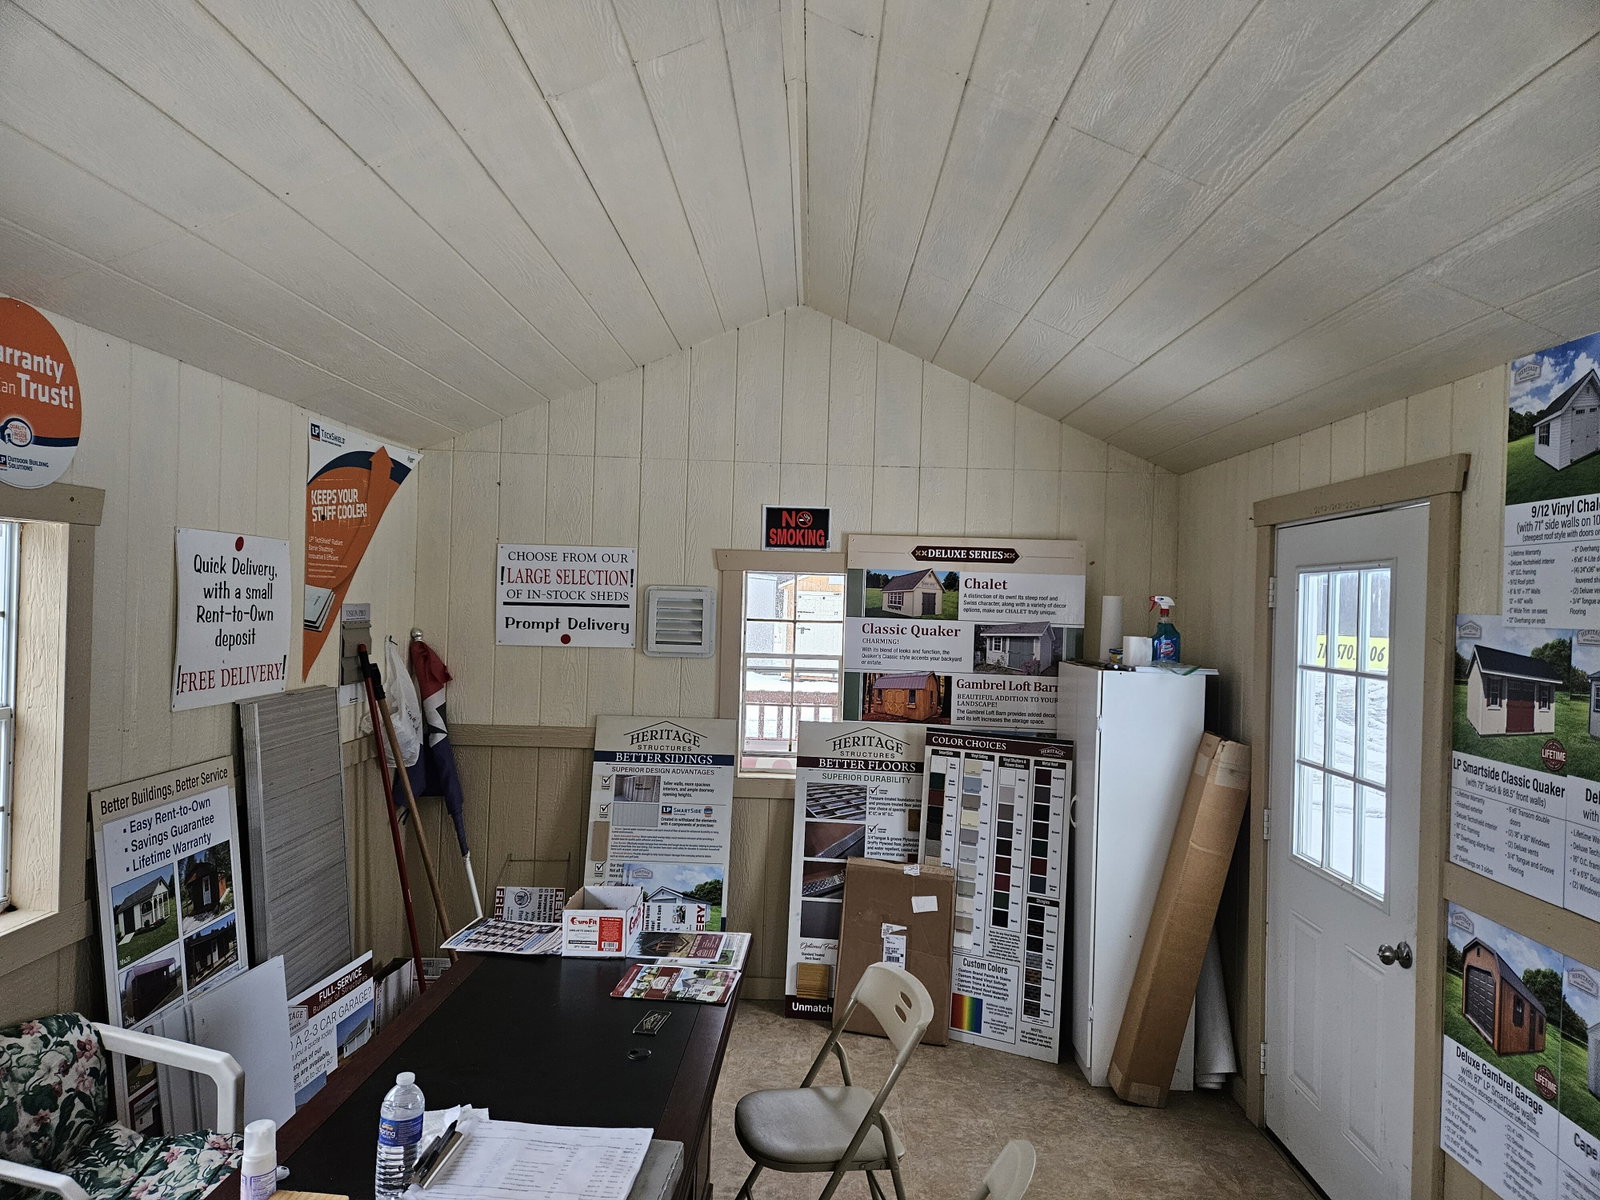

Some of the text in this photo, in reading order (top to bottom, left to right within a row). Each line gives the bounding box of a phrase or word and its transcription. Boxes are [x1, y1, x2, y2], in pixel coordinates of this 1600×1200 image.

[0, 345, 64, 384] rranty
[0, 372, 74, 409] an Trust!
[311, 488, 359, 505] KEEPS YOUR
[337, 503, 368, 519] COOLER!
[1531, 497, 1600, 518] 9/12 Vinyl Chal
[1545, 517, 1560, 530] side
[1561, 516, 1580, 528] walls
[1581, 517, 1590, 526] on
[769, 528, 825, 546] SMOKING
[508, 551, 629, 564] CHOOSE FROM OUR
[928, 548, 1003, 560] DELUXE SERIES
[194, 554, 278, 581] Quick Delivery,
[203, 581, 274, 600] with a small
[964, 577, 1008, 591] Chalet
[506, 589, 630, 602] OF IN-STOCK SHEDS
[196, 604, 275, 623] Rent-to-Own
[504, 616, 630, 635] Prompt Delivery
[862, 623, 961, 639] Classic Quaker
[214, 627, 257, 651] deposit
[957, 679, 1006, 692] Gambrel
[1009, 681, 1031, 692] Loft
[957, 693, 994, 701] BEAUTIFUL
[630, 728, 701, 748] HERITAGE
[832, 735, 904, 756] HERITAGE
[932, 736, 1007, 751] COLOR CHOICES
[637, 744, 693, 752] STRUCTURES
[840, 750, 896, 759] STRUCTURES
[1541, 749, 1566, 762] LIFETIME
[615, 753, 713, 765] BETTER SIDINGS
[819, 758, 916, 773] BETTER FLOORS
[611, 766, 645, 774] SUPERIOR
[646, 767, 671, 775] DESIGN
[822, 773, 912, 784] SUPERIOR DURABILITY
[1453, 758, 1566, 798] LP Smartside Classic Quaker
[100, 768, 228, 816] Better Buildings, Better Service
[1516, 790, 1530, 803] front
[130, 798, 211, 834] Easy Rent-to-Own
[1582, 810, 1600, 822] with
[131, 815, 214, 853] Savings Guarantee
[132, 832, 212, 872] Lifetime Warranty
[963, 958, 1008, 975] Custom Colors
[318, 966, 363, 1002] FULL-SERVICE
[304, 1024, 318, 1043] 2-3
[320, 1011, 337, 1031] CAR
[338, 986, 372, 1018] GARAGE?
[1456, 1046, 1543, 1115] Deluxe Gambrel Garage
[1461, 1066, 1473, 1081] with
[1483, 1080, 1490, 1091] LP
[1491, 1084, 1521, 1114] Smartside
[1521, 1108, 1536, 1125] walls
